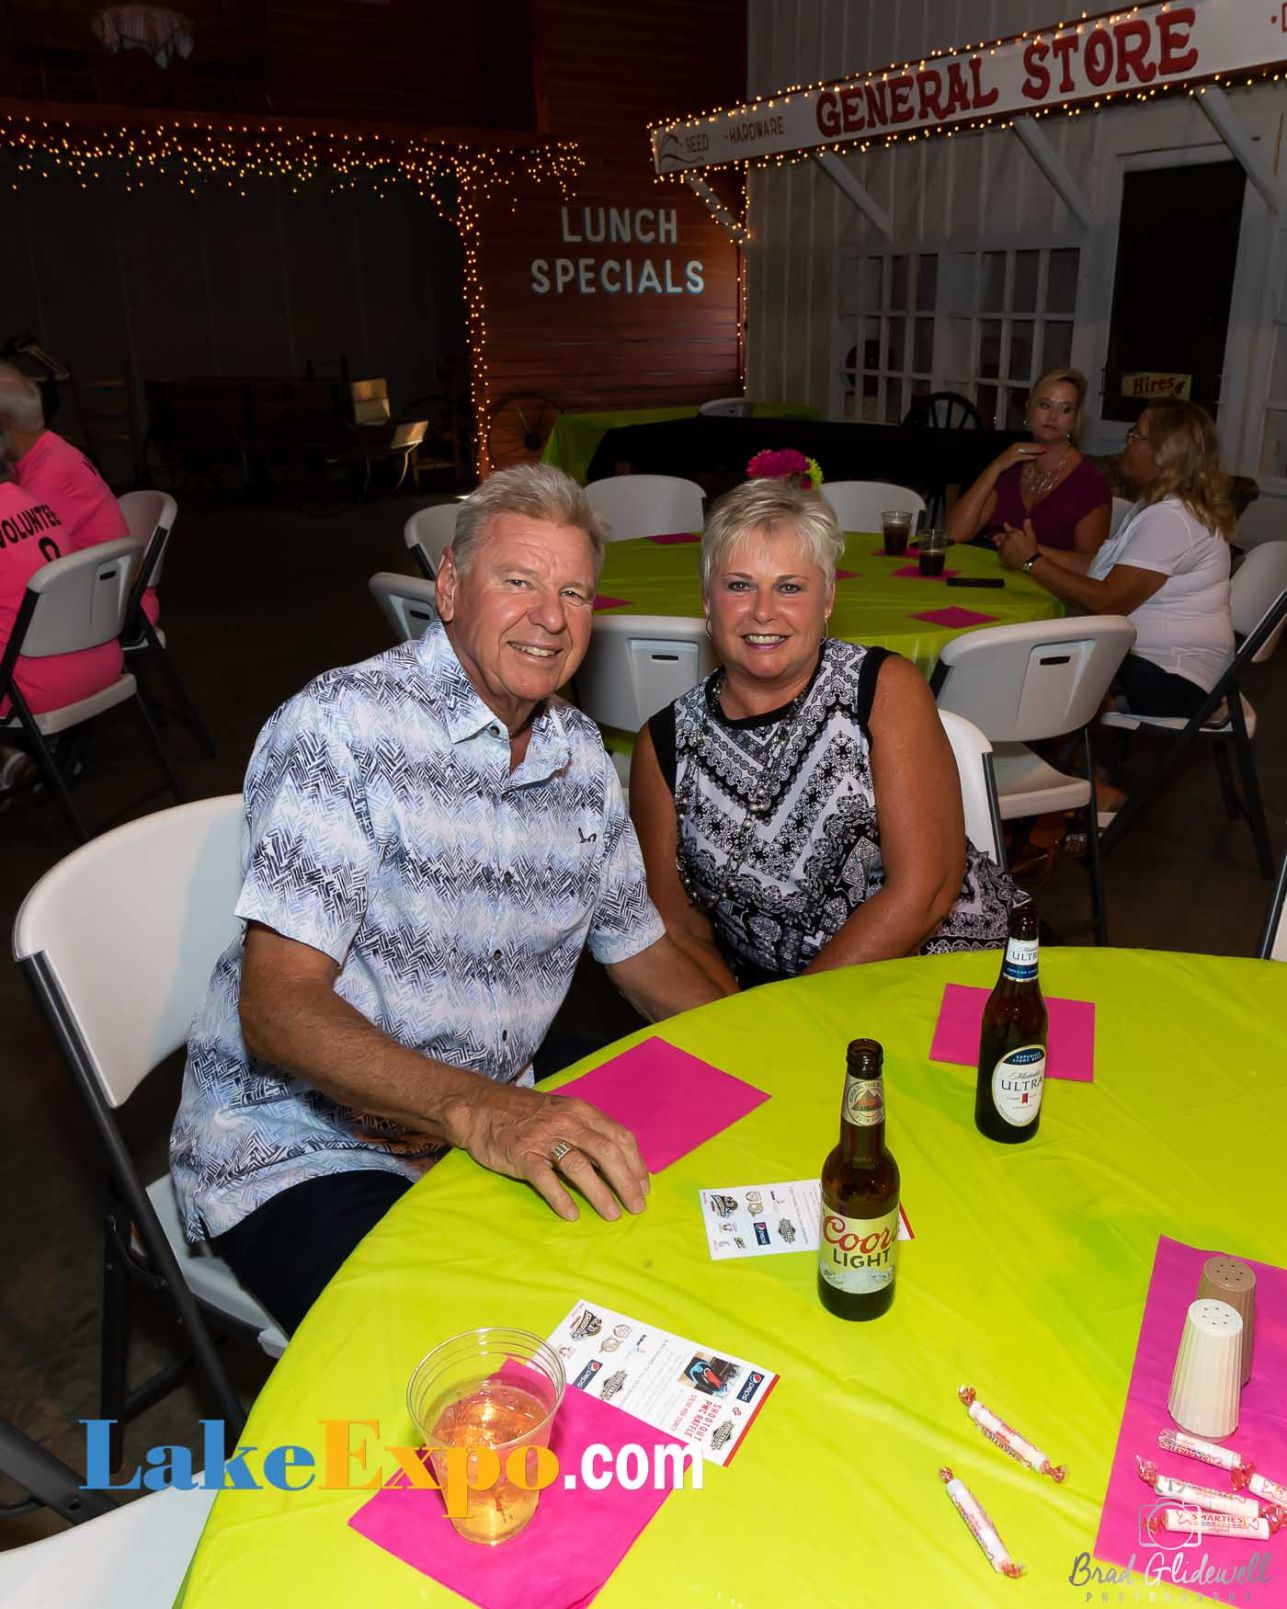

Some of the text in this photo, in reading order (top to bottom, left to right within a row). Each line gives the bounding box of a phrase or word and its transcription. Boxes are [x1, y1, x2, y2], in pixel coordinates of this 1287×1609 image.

[816, 8, 1199, 137] GENERAL STORE
[560, 206, 678, 243] LUNCH
[531, 258, 705, 294] SPECIALS
[1132, 376, 1176, 396] Hires
[1000, 1076, 1042, 1092] ULTRA
[833, 1247, 890, 1269] LIGHT
[683, 1415, 704, 1439] RAFFLE
[693, 1402, 722, 1442] SHOOTOUT
